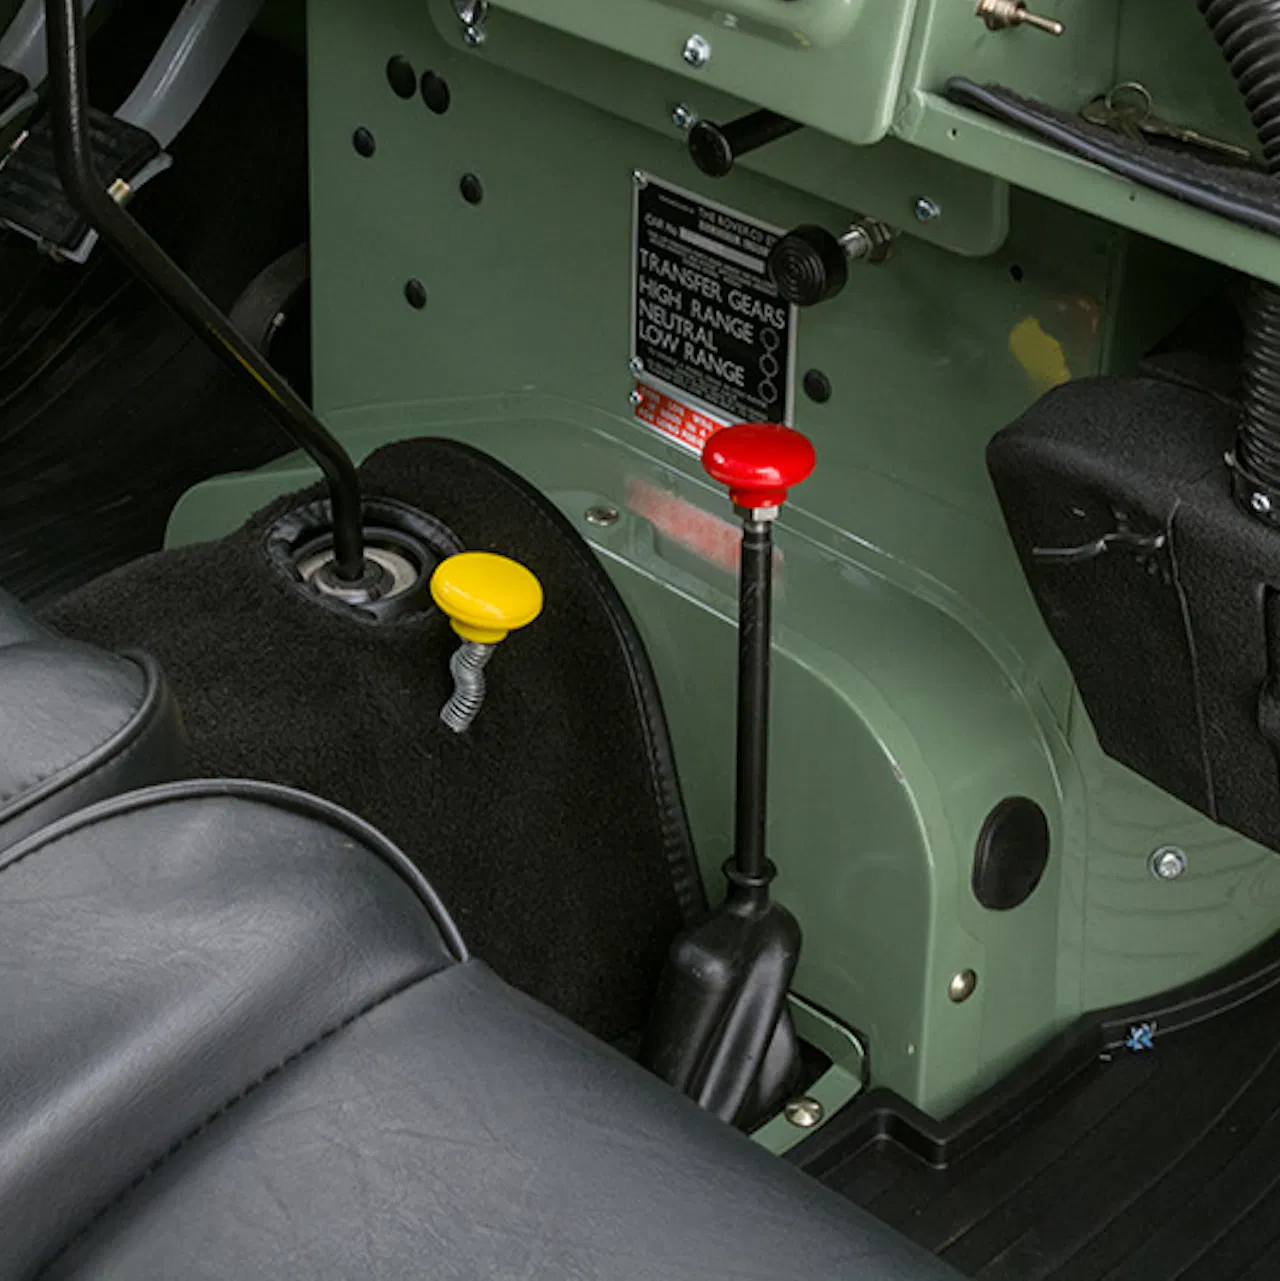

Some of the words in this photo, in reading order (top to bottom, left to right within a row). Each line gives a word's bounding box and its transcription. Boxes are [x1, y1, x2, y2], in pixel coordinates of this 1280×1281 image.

[639, 247, 723, 303] TRANSFER
[727, 289, 786, 330] GEARS
[639, 274, 683, 311] HIGH
[690, 298, 754, 344] RANGE
[639, 298, 719, 354] NEUTRAL
[639, 320, 680, 353] LOW
[683, 341, 745, 387] RANGE
